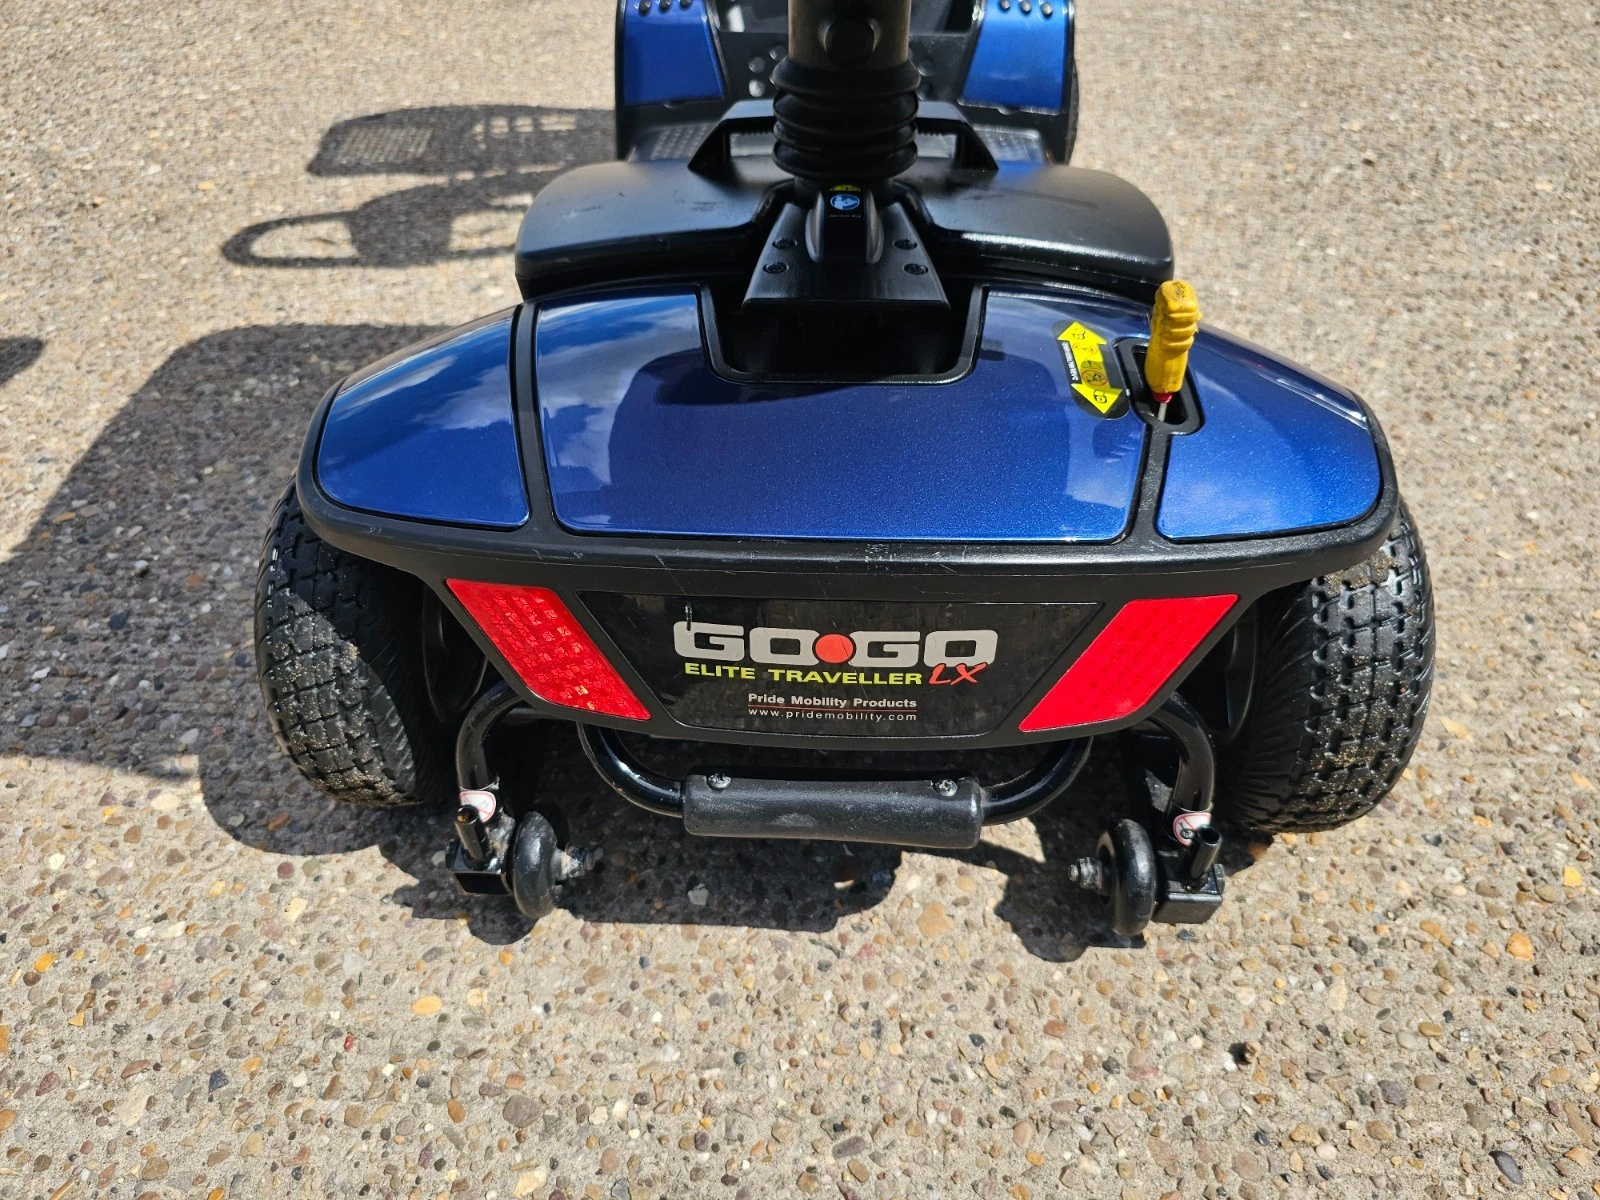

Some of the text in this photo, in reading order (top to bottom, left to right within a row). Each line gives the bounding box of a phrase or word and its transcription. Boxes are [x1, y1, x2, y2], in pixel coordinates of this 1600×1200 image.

[684, 661, 988, 686] ELITE TRAVELLER LX
[748, 692, 917, 709] Pride Mobility Products
[748, 707, 917, 721] www.pridemobility.com
